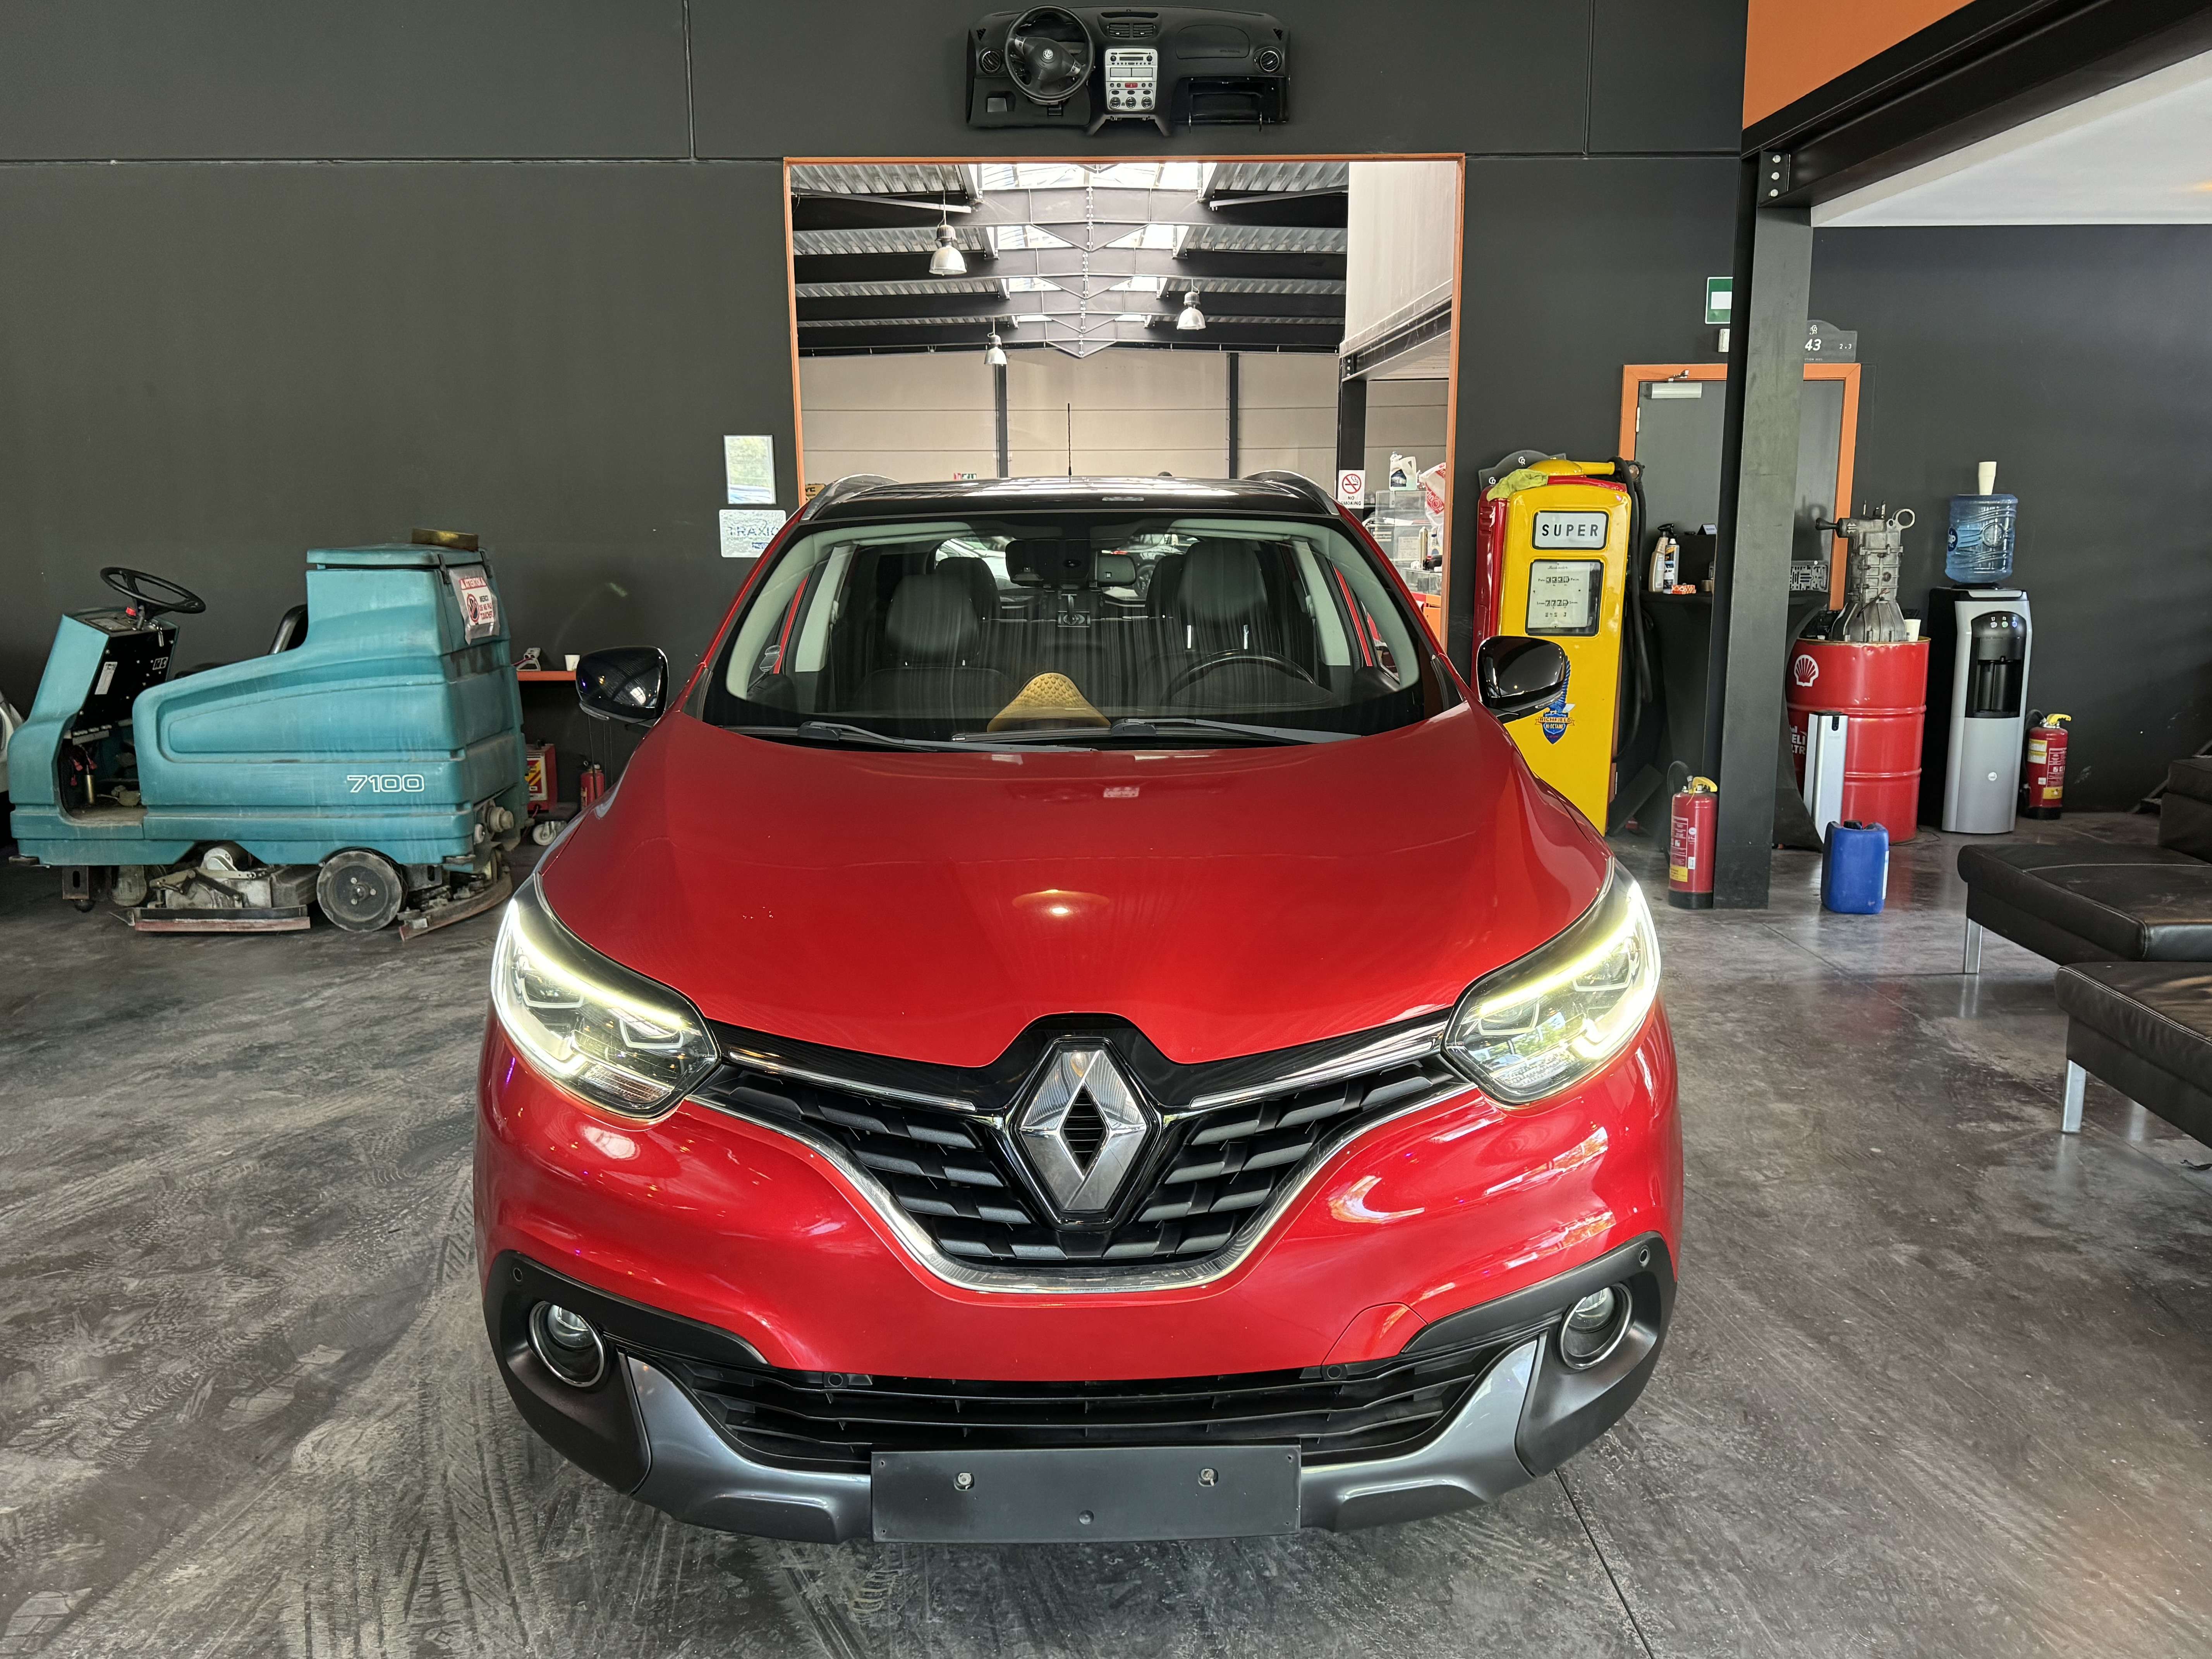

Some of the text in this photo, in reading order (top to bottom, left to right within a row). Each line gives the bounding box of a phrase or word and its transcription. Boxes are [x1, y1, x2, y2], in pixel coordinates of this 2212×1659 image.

[1542, 524, 1598, 537] SUPER
[1791, 733, 1806, 745] ELI
[347, 775, 424, 793] 7100
